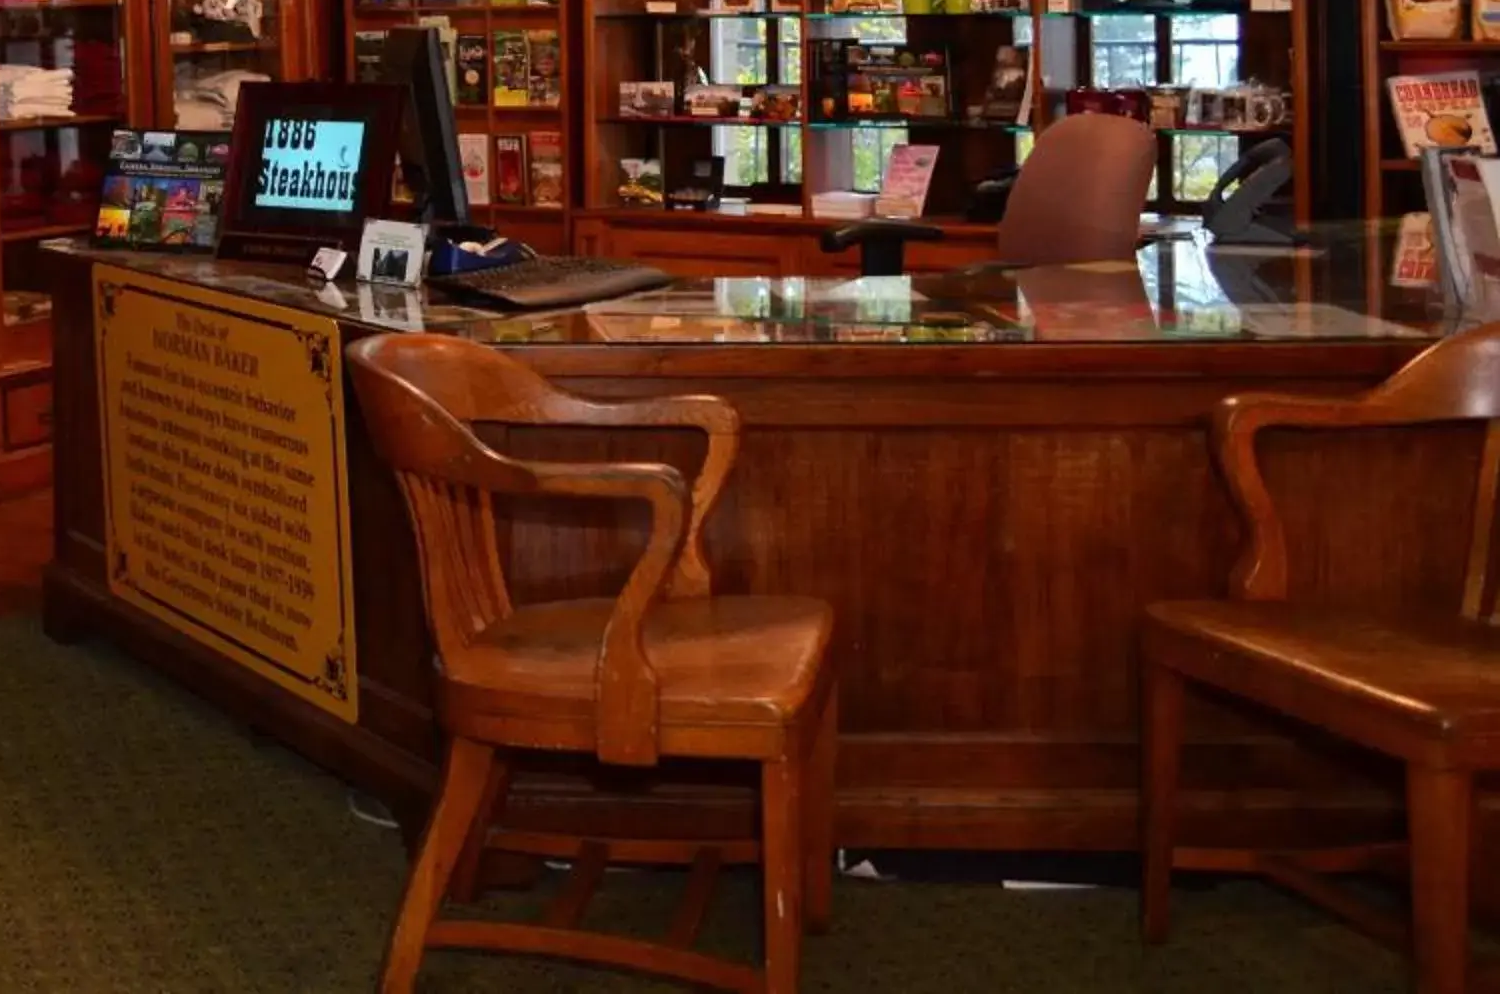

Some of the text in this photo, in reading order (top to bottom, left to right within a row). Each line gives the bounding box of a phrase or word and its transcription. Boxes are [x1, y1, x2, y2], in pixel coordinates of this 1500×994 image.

[265, 120, 315, 150] 1886
[152, 326, 258, 376] NORMAN BAKER
